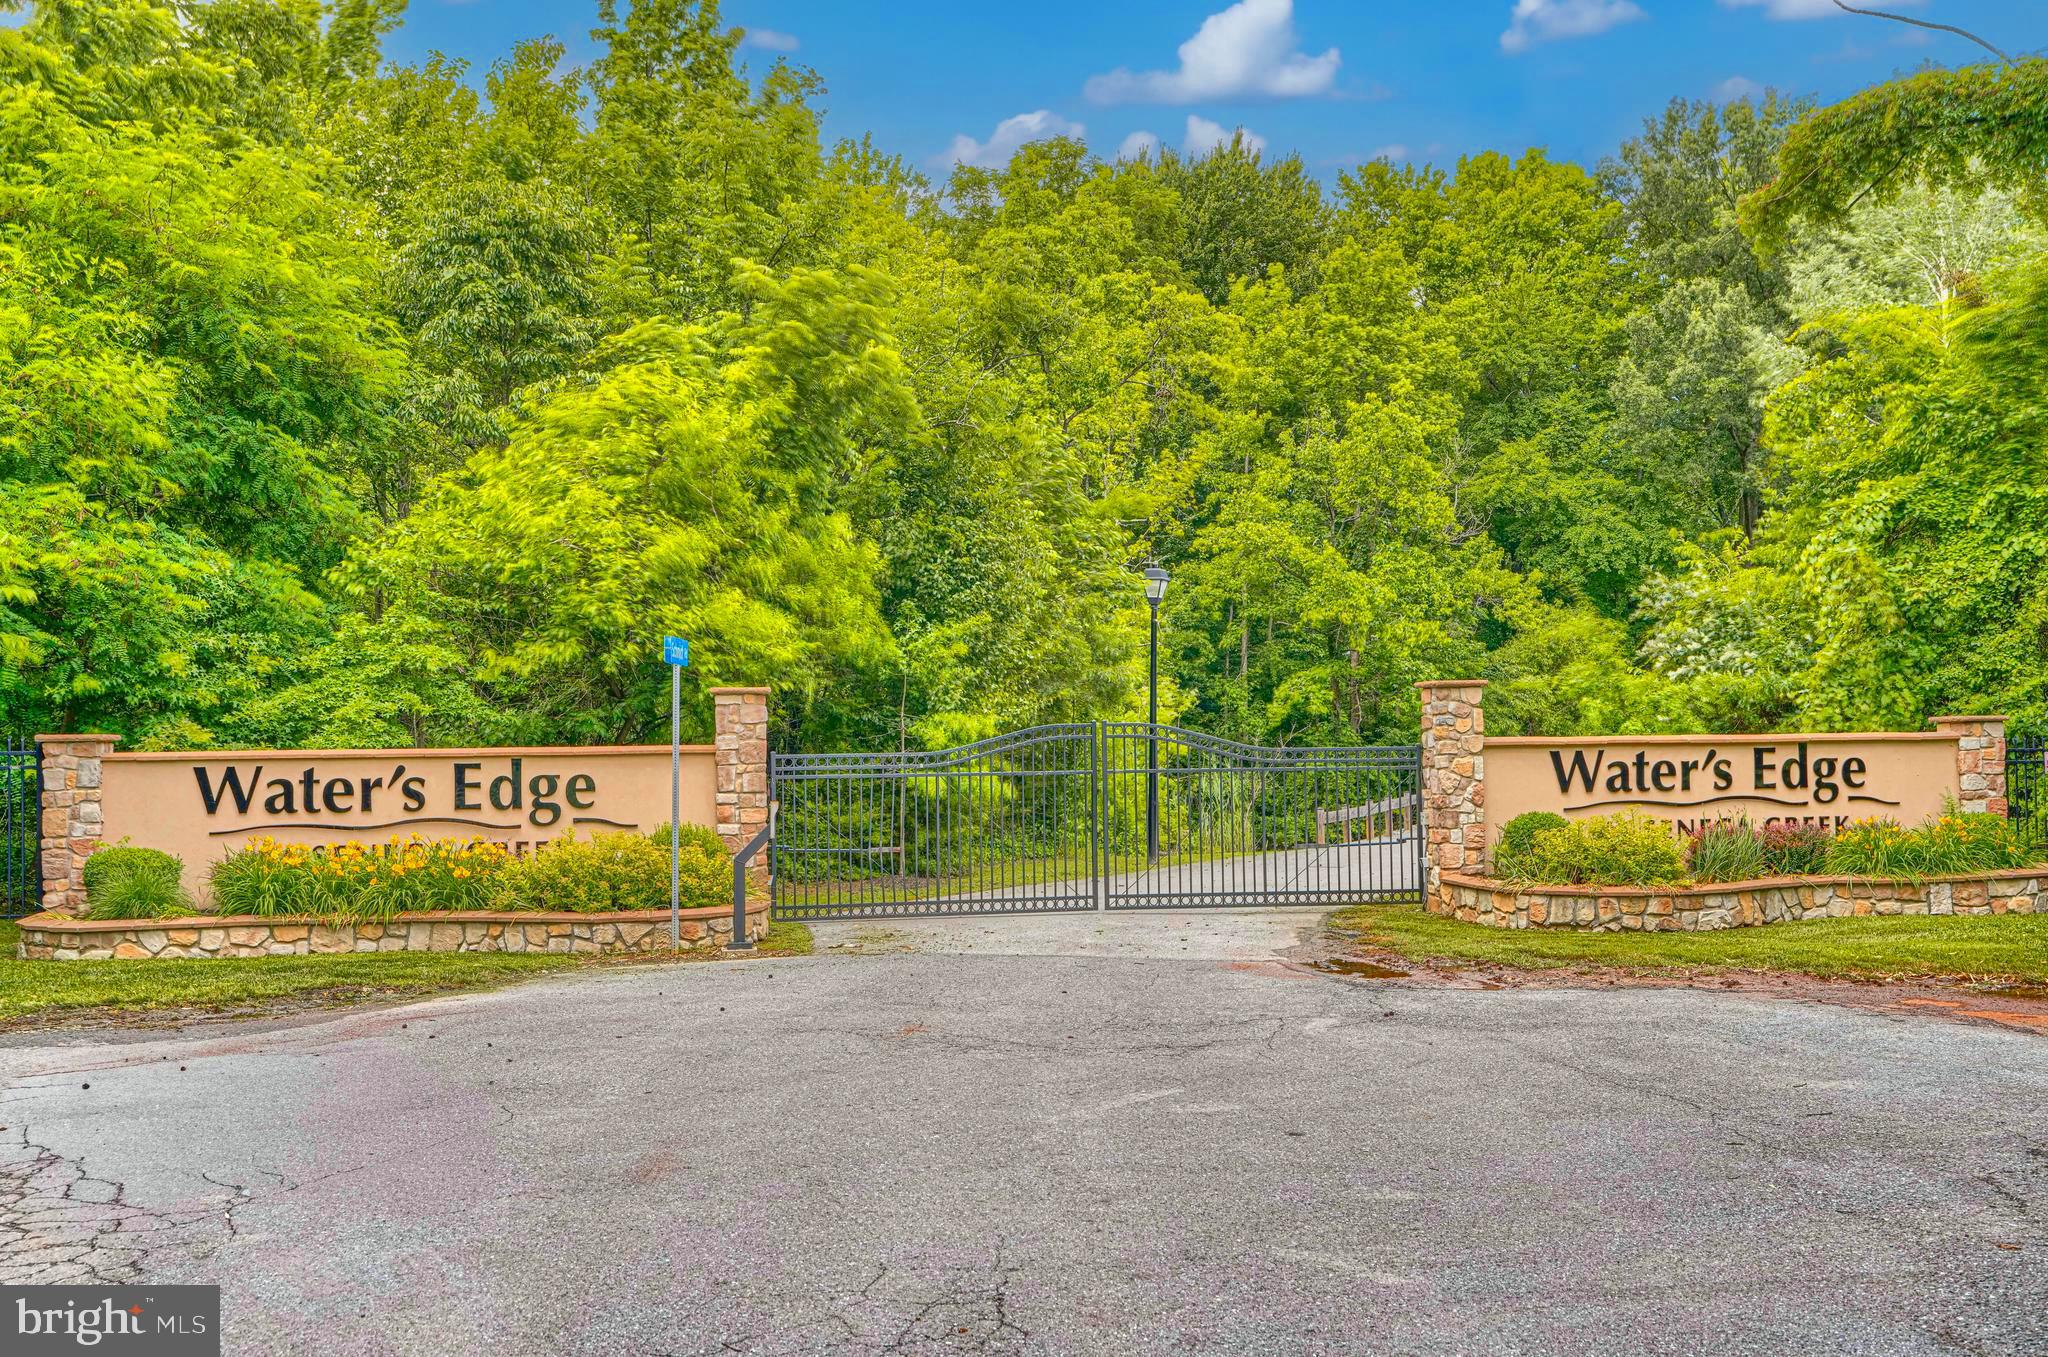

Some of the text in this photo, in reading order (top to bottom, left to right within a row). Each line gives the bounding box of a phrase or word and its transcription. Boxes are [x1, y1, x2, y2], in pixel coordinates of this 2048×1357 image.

[193, 758, 596, 828] Water's Edge
[1549, 743, 1867, 804] Water's Edge
